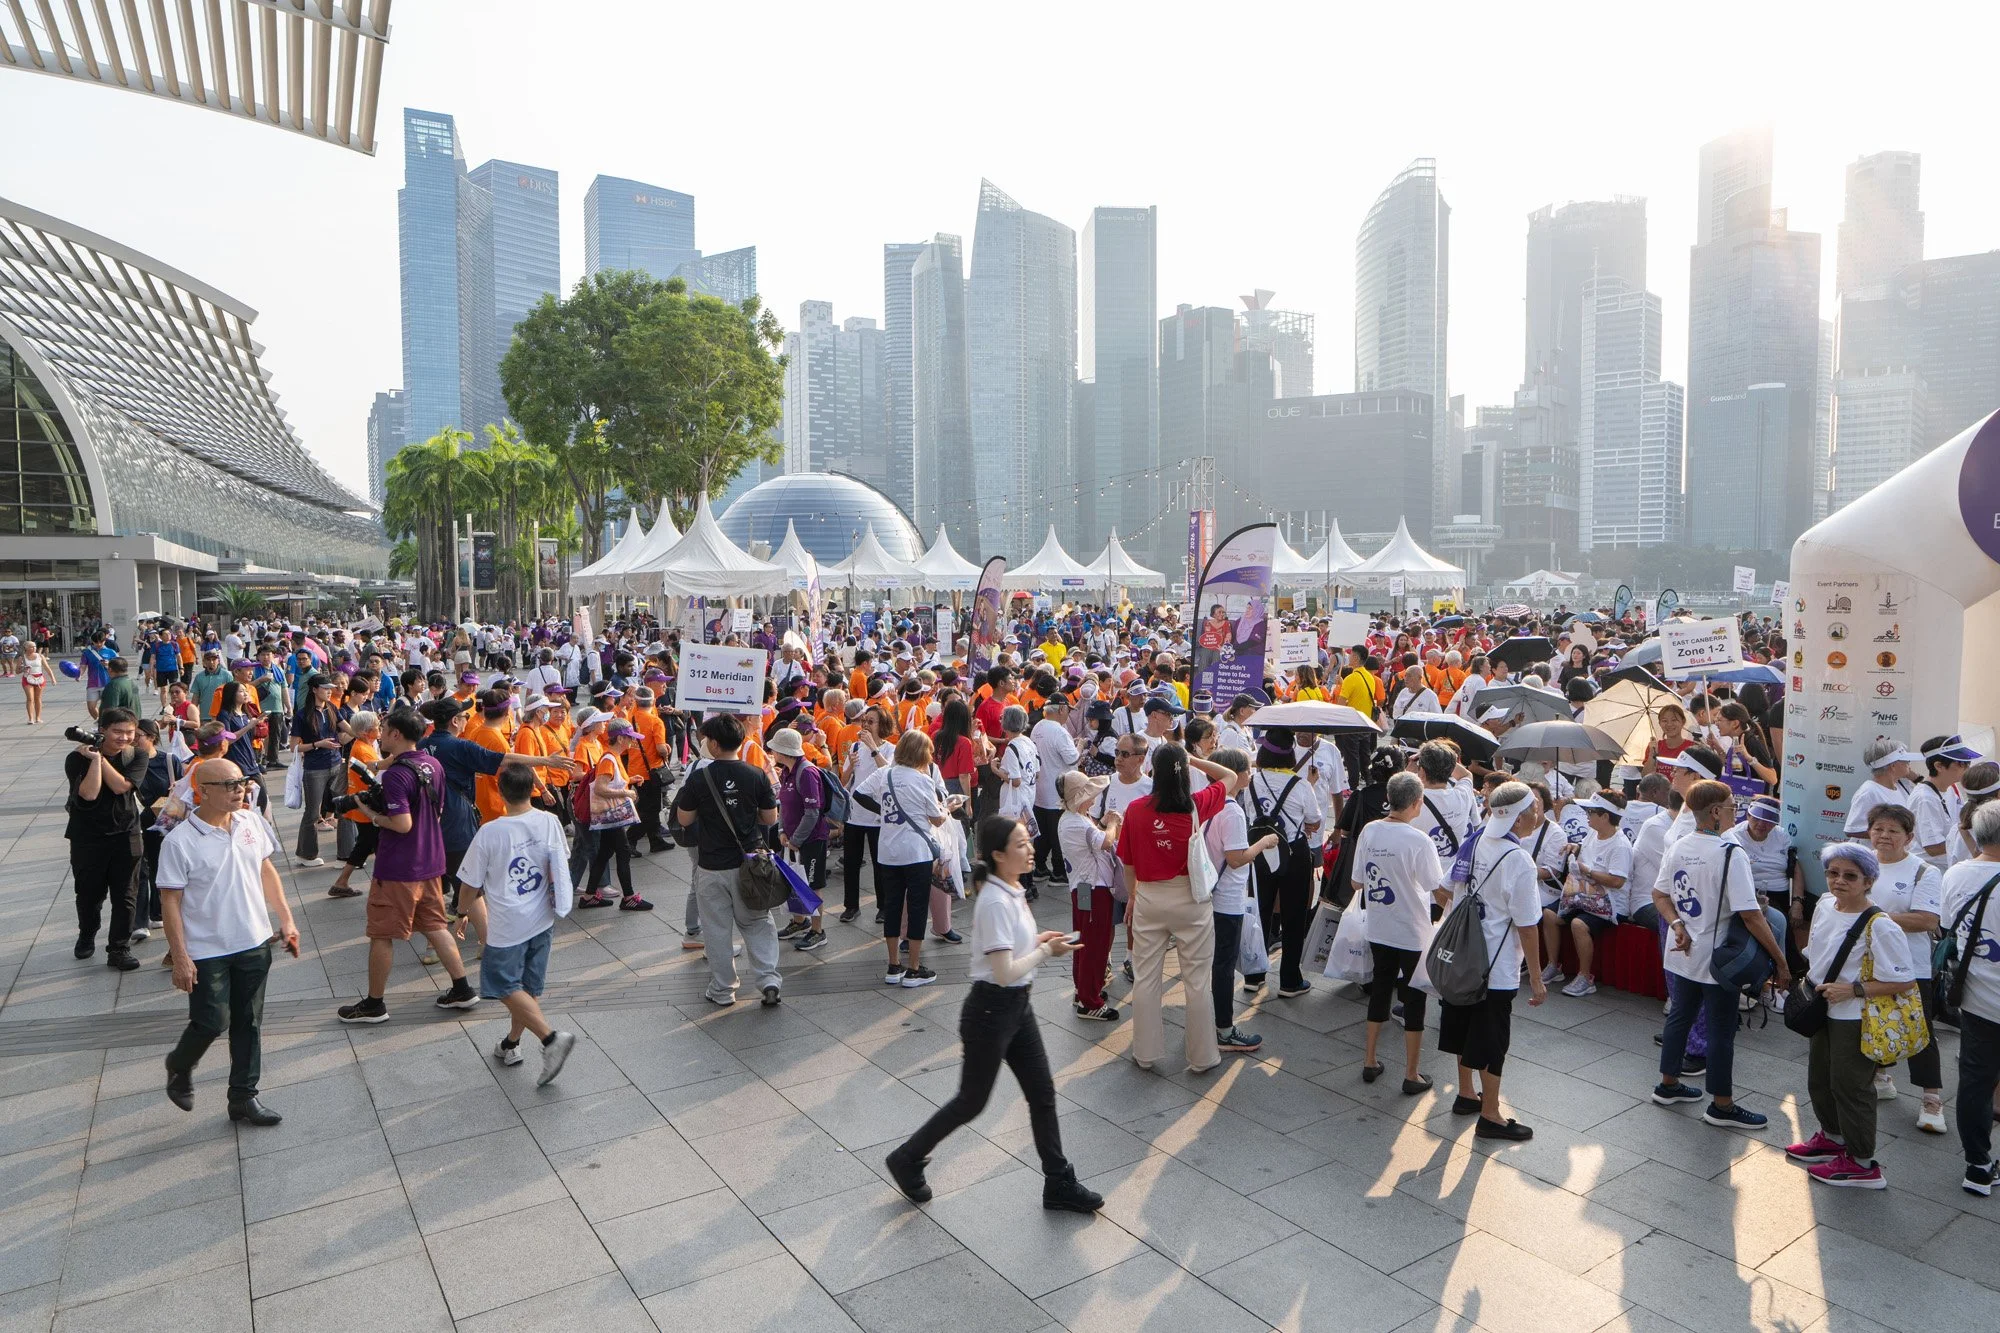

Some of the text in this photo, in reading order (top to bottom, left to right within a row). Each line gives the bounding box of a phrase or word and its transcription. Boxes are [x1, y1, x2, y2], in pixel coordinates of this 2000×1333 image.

[651, 199, 677, 208] HSBC
[1710, 393, 1748, 403] GuocoLand
[1267, 406, 1302, 419] OUE
[1672, 635, 1728, 647] EAST CANBERRA
[1678, 643, 1725, 657] Zone 1-2
[1689, 657, 1705, 665] Bus
[690, 669, 754, 682] 312 Meridian
[705, 685, 735, 695] Bus 13
[1826, 789, 1841, 798] ups
